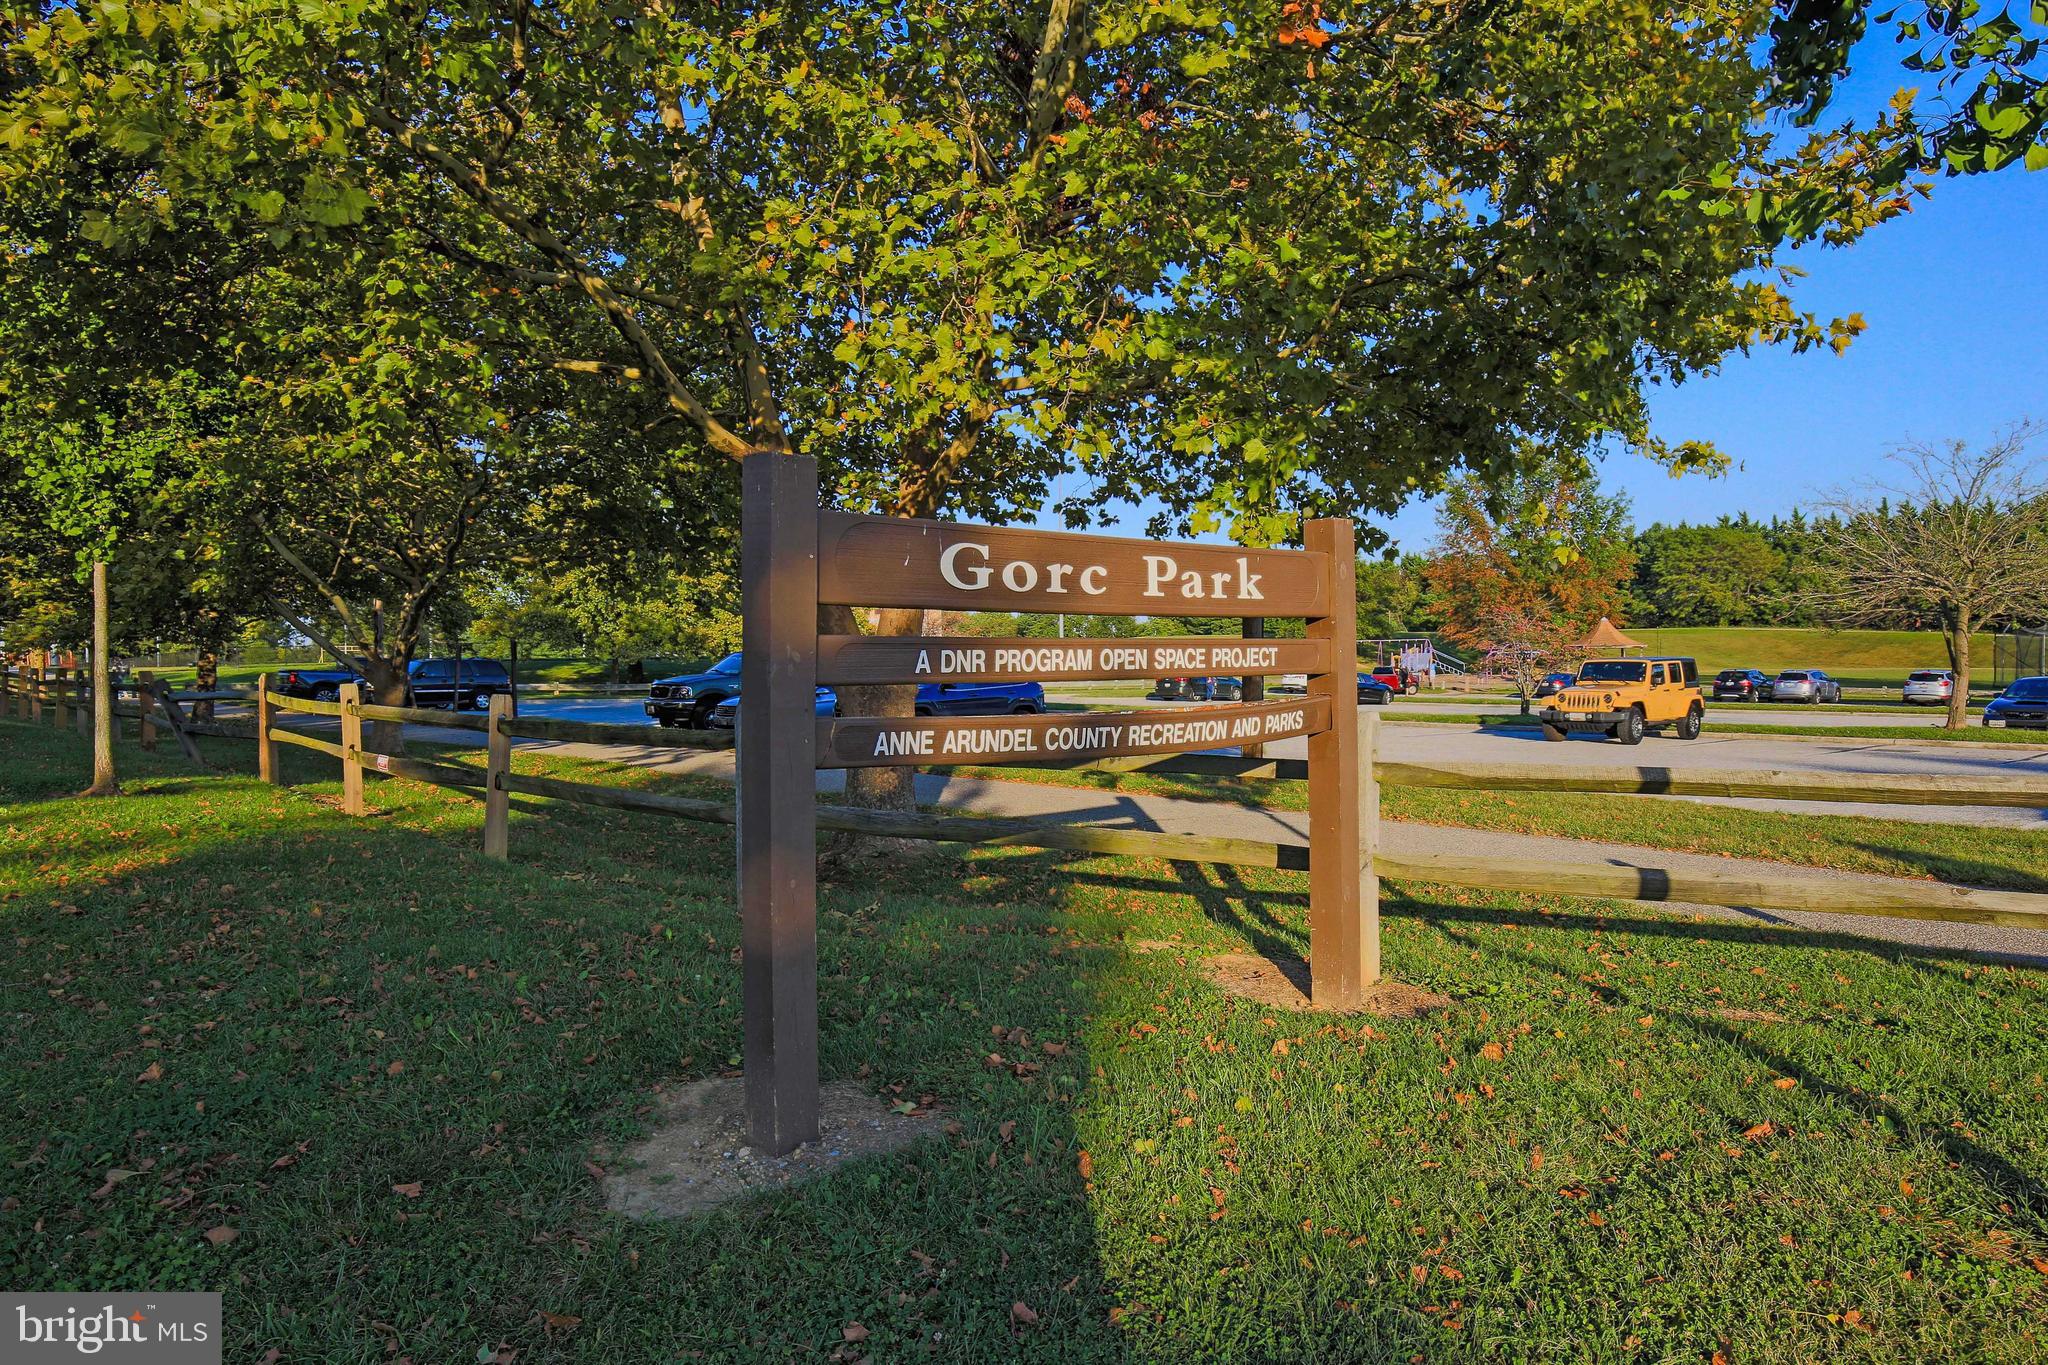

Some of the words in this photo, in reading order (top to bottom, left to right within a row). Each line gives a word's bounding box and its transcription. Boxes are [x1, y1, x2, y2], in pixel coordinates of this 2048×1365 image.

[940, 542, 1108, 595] Gorc
[1142, 555, 1264, 599] Park
[915, 649, 931, 674] A
[940, 649, 986, 673] DNR
[995, 648, 1092, 673] PROGRAM
[1100, 648, 1148, 671] OPEN
[1154, 647, 1206, 670] SPACE
[1211, 647, 1278, 669] PROJECT
[873, 730, 935, 756] ANNE
[942, 728, 1038, 754] ARUNDEL
[1045, 726, 1122, 750] COUNTY
[1128, 720, 1227, 746] RECREATION
[1231, 716, 1261, 738] AND
[1265, 710, 1304, 734] PARKS
